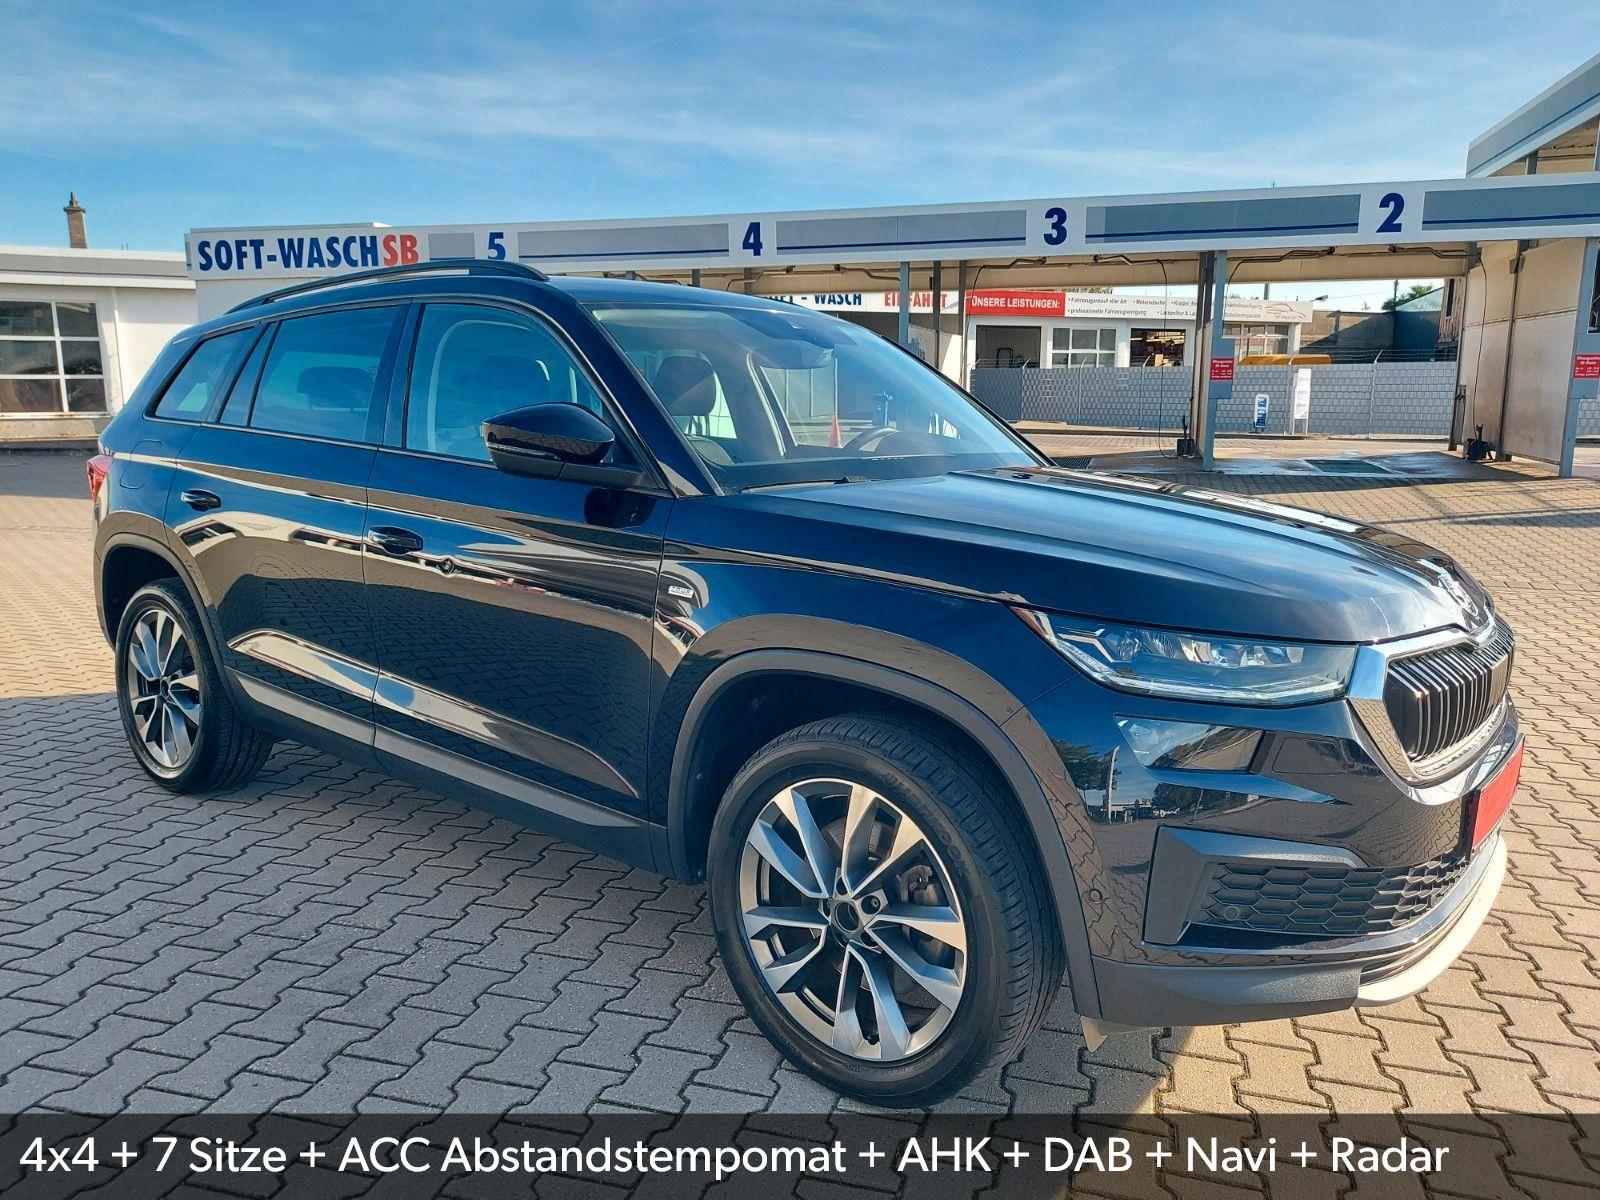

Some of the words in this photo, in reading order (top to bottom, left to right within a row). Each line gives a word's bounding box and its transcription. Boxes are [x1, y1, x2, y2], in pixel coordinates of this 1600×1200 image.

[1043, 207, 1068, 245] 3
[1376, 192, 1405, 233] 2
[487, 231, 506, 261] 5
[742, 221, 763, 256] 4
[885, 291, 948, 308] EIAHT
[971, 296, 1006, 308] UNSERE
[1007, 297, 1060, 309] LEISTUNGEN:
